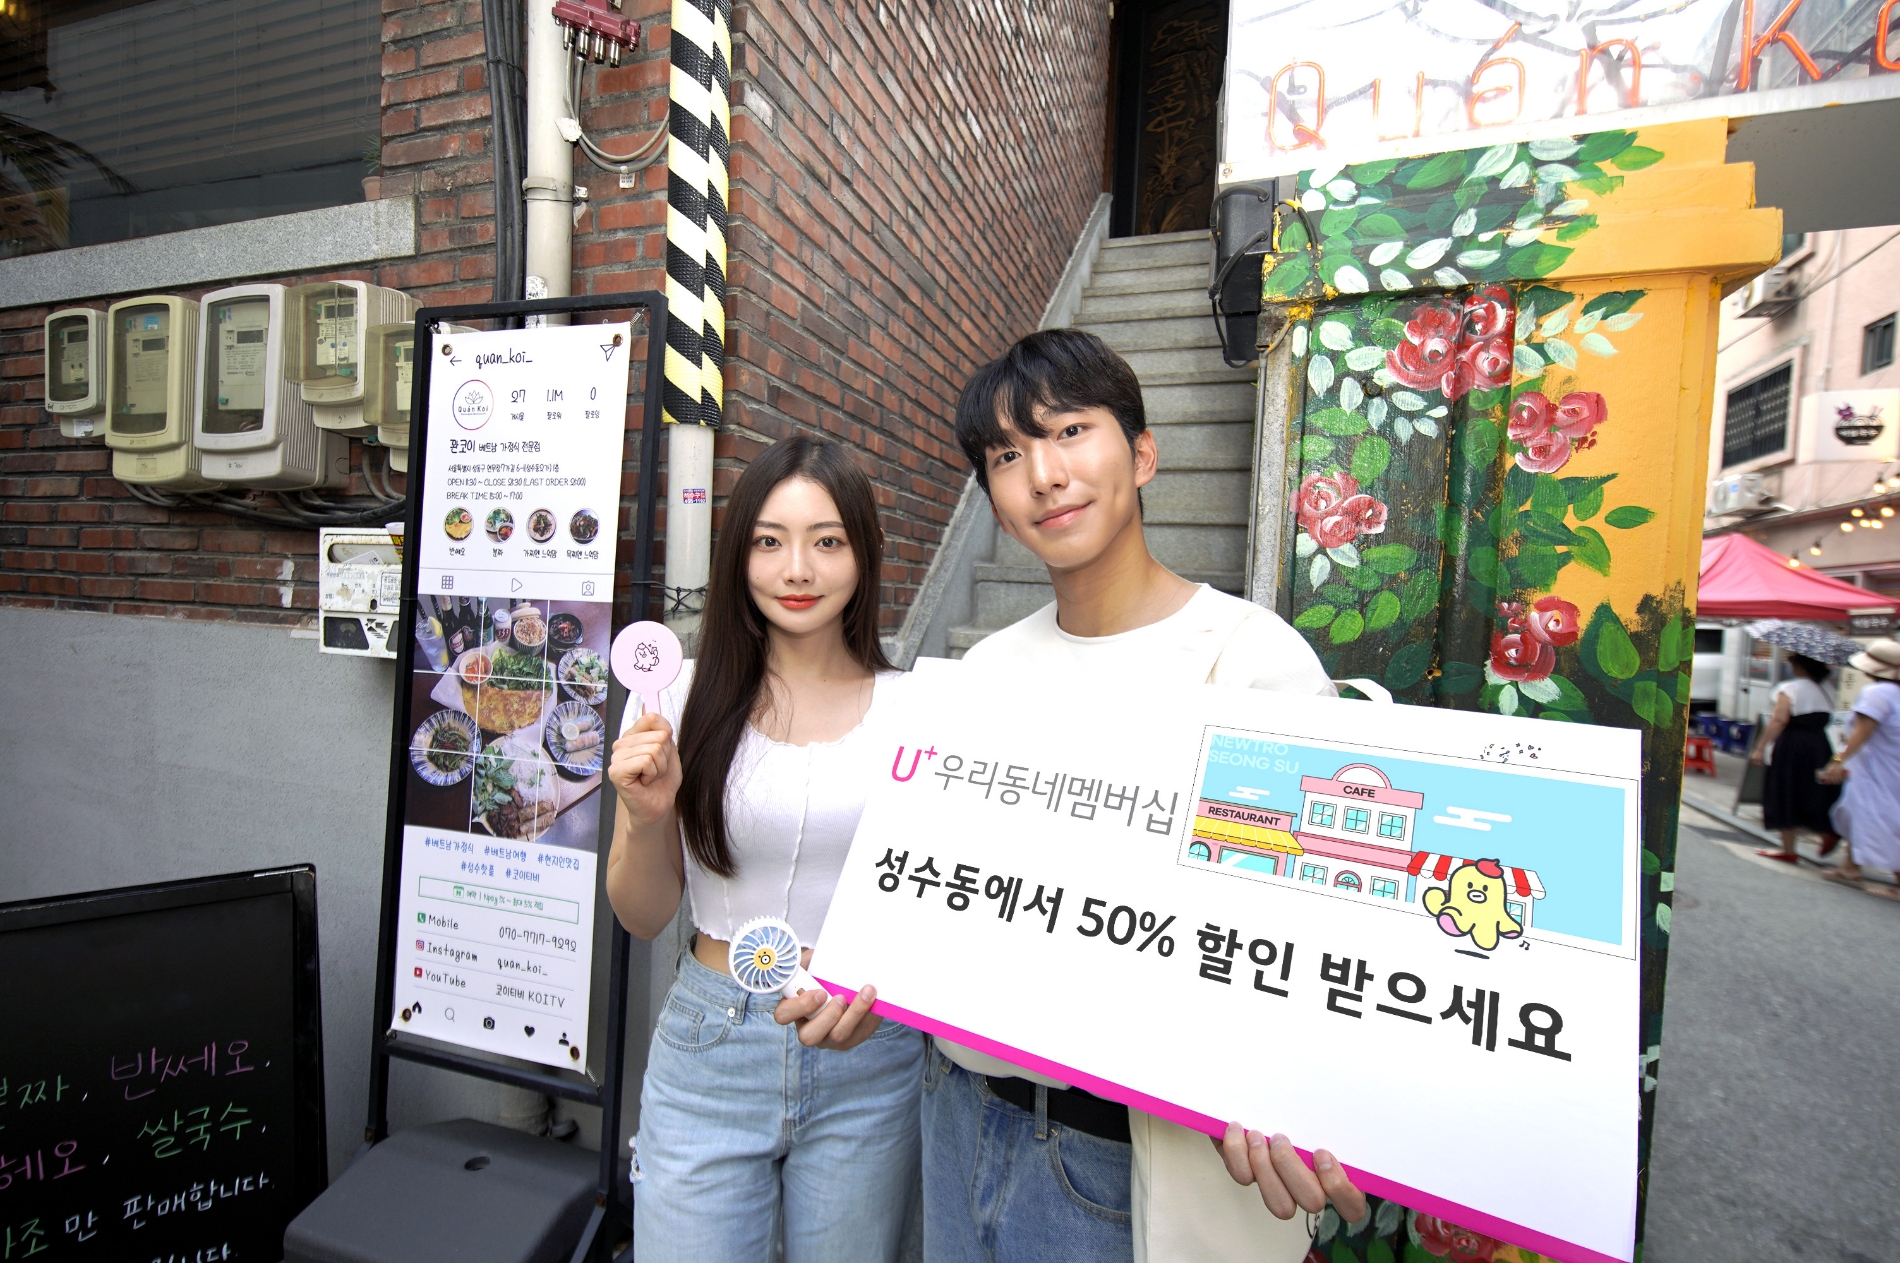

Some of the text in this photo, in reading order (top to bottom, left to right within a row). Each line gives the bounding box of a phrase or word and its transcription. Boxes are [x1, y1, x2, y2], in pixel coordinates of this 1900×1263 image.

[475, 348, 533, 369] quan_koi_
[511, 387, 597, 403] 27 1.1M 0
[547, 411, 562, 421] 팔로워
[585, 410, 600, 419] 팔로잉
[478, 442, 498, 453] 베트남
[500, 441, 520, 453] 가정식
[521, 440, 541, 453] 전문점
[447, 478, 465, 486] OPEN
[484, 478, 506, 486] CLOSE
[545, 478, 569, 486] ORDER
[446, 491, 468, 500] BREAK
[470, 491, 488, 500] TIME
[1208, 751, 1299, 775] SEONG SU
[1343, 785, 1376, 799] CAFE
[1207, 805, 1281, 827] RESTAURANT
[425, 837, 580, 871] #베트남가정식 #베트남여행 #현지인맛집
[461, 861, 540, 883] #성수핫플 #코이티비
[428, 914, 459, 930] Mobile
[427, 942, 548, 976] Instagram quan_koi_
[875, 847, 1572, 1063] 성수동에서 50% 할인 받으세요
[425, 969, 565, 1008] YouTube 코이티비 KOITV
[65, 1209, 99, 1243] 만
